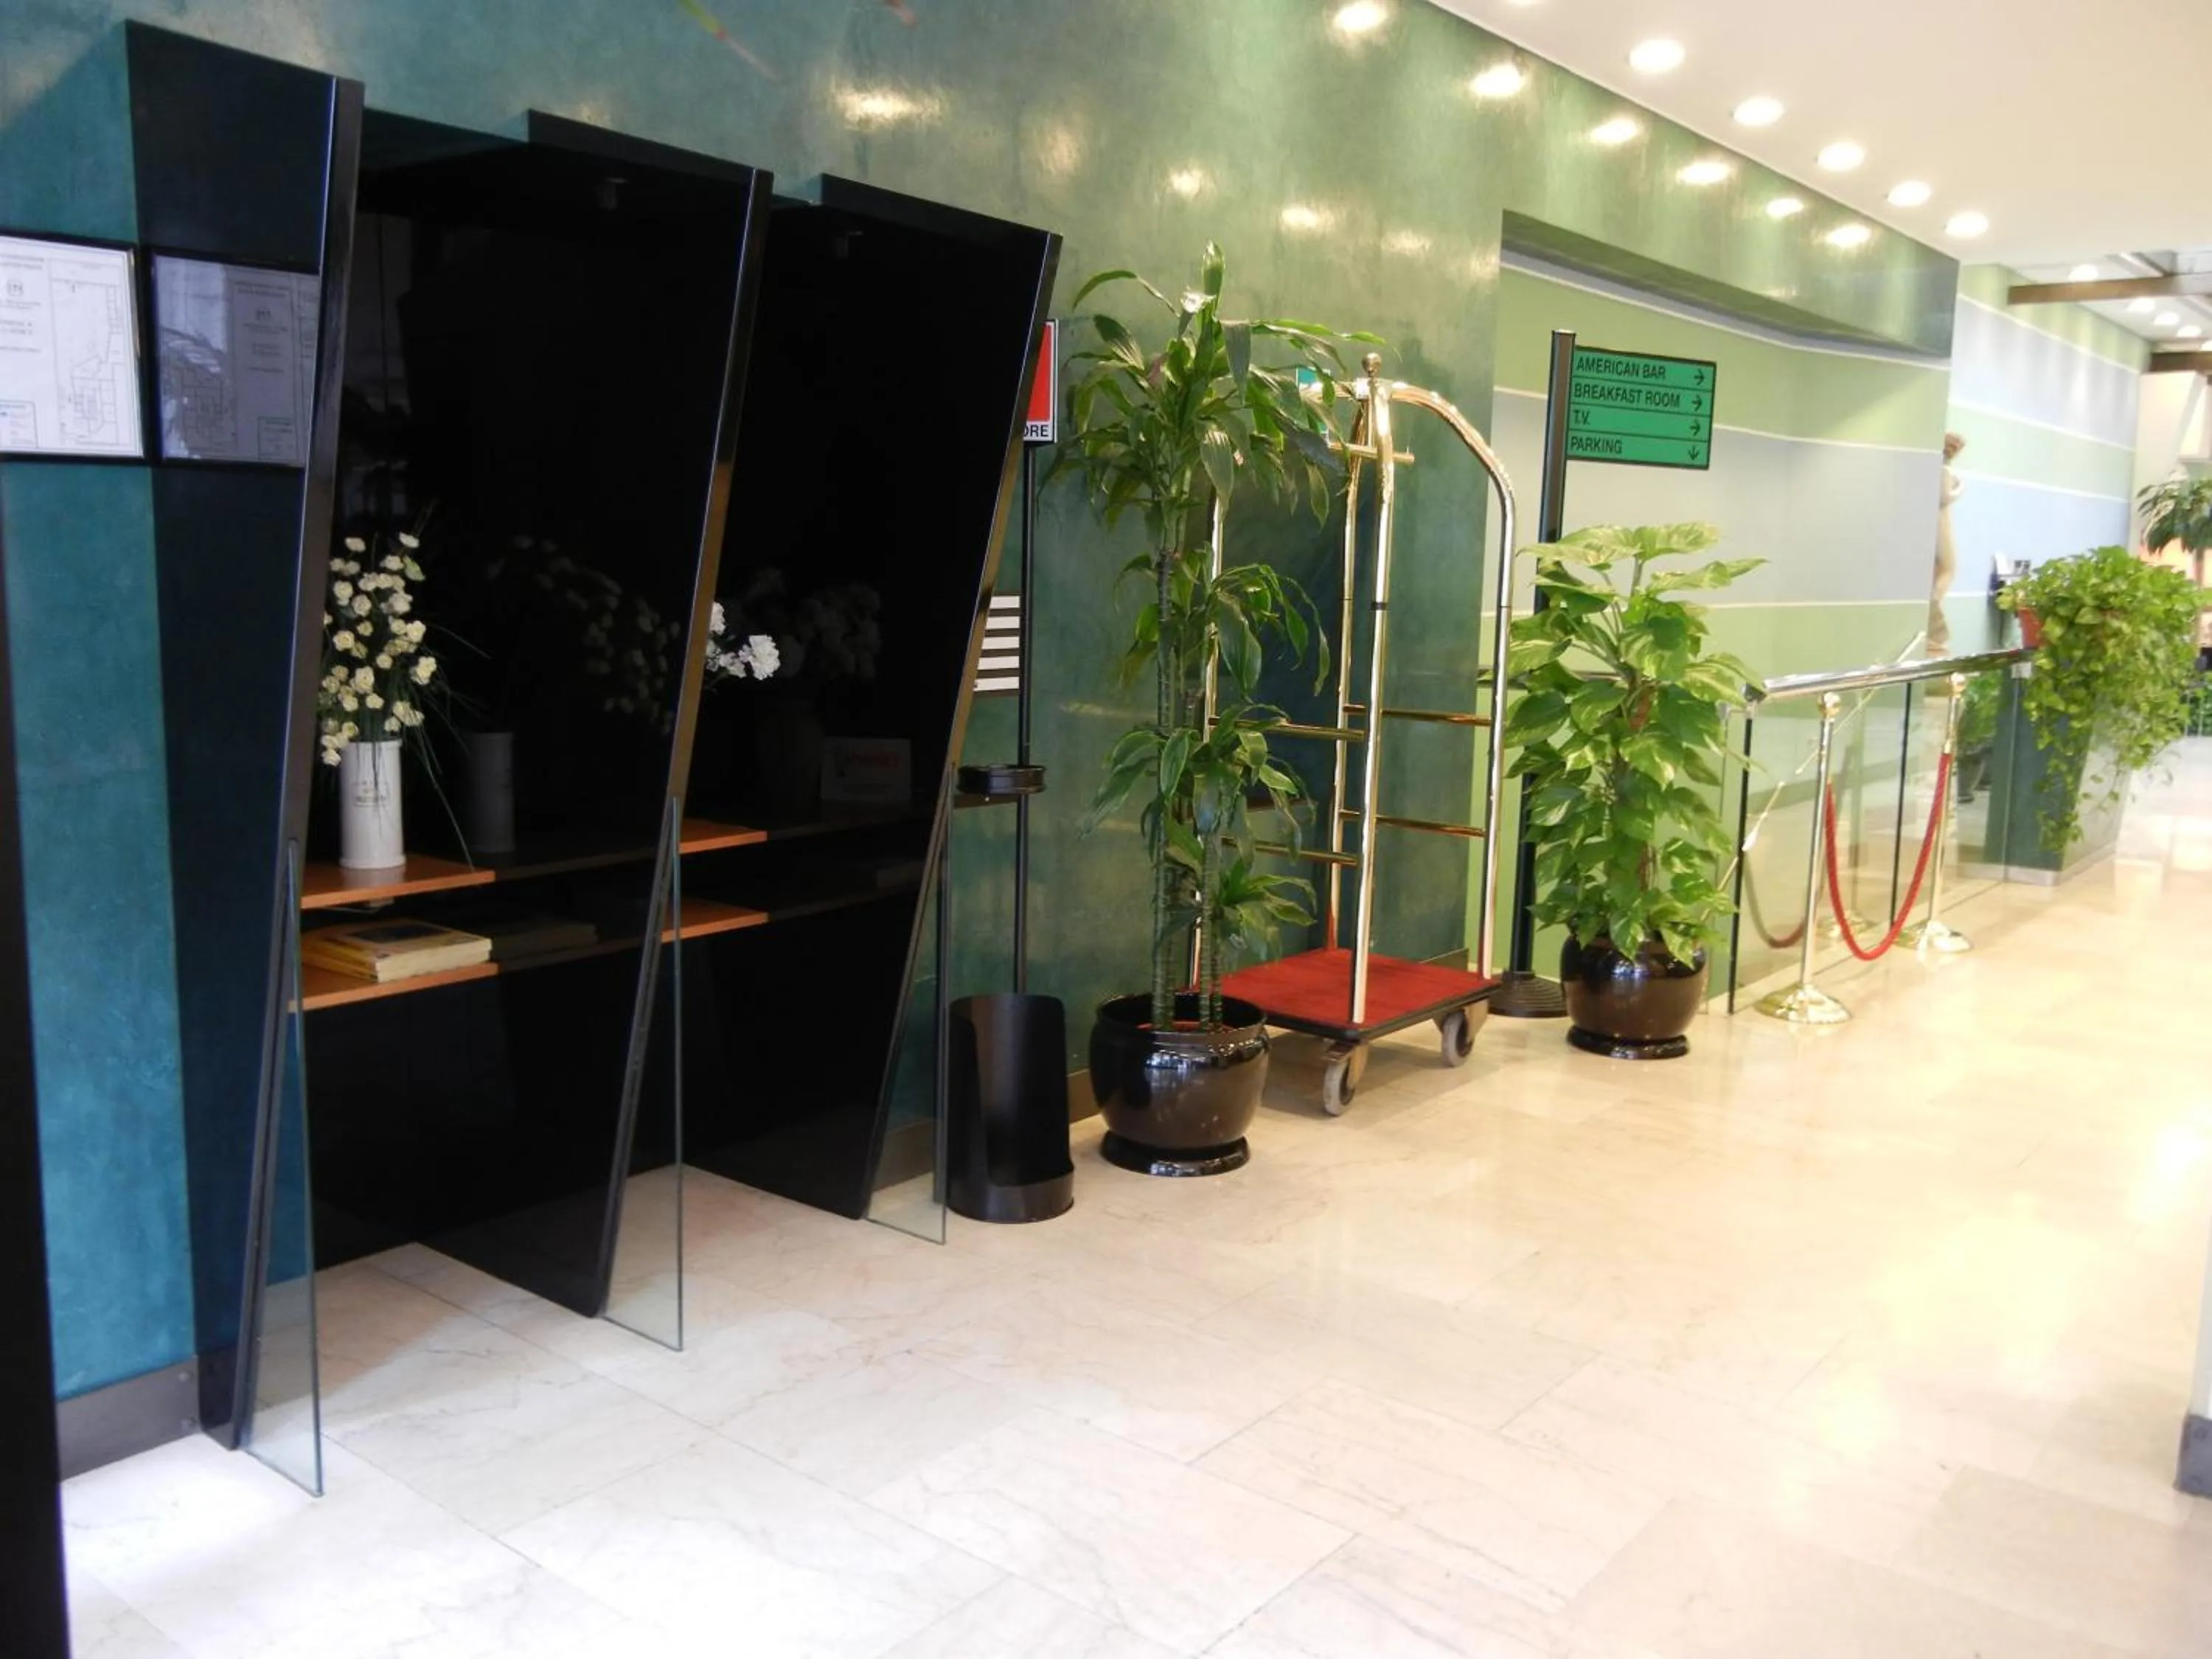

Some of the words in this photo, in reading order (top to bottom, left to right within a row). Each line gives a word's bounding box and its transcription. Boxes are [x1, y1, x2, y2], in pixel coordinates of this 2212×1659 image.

[1576, 357, 1640, 378] AMERICAN
[1642, 364, 1666, 380] BAR
[1573, 383, 1643, 404] BREAKFAST
[1645, 391, 1681, 408] ROOM
[1571, 436, 1623, 454] PARKING
